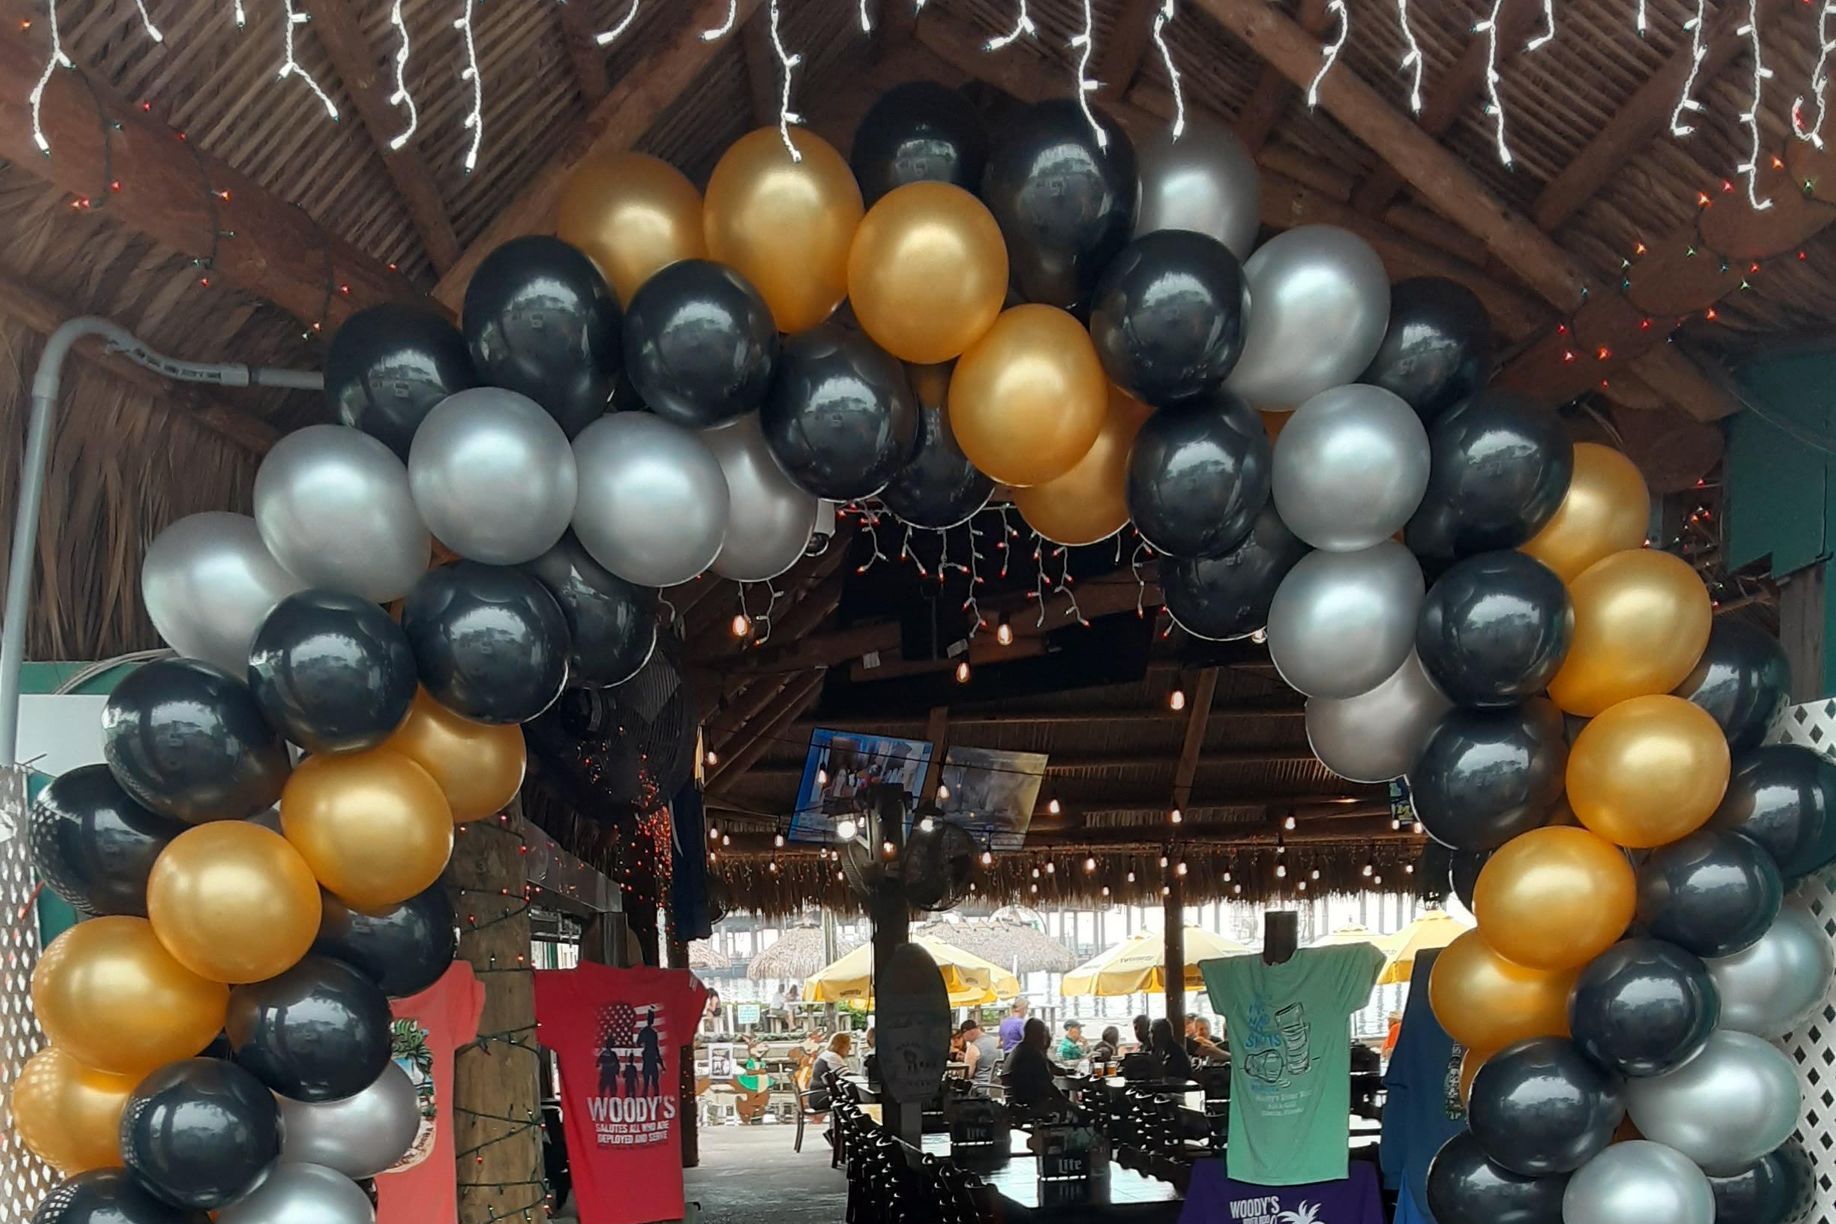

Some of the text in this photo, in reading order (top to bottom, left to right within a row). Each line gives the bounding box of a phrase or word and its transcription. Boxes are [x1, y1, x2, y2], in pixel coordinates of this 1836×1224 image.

[587, 1096, 676, 1123] WOODY'S
[1059, 1159, 1082, 1173] Lite
[1230, 1196, 1280, 1219] WOODY'S
